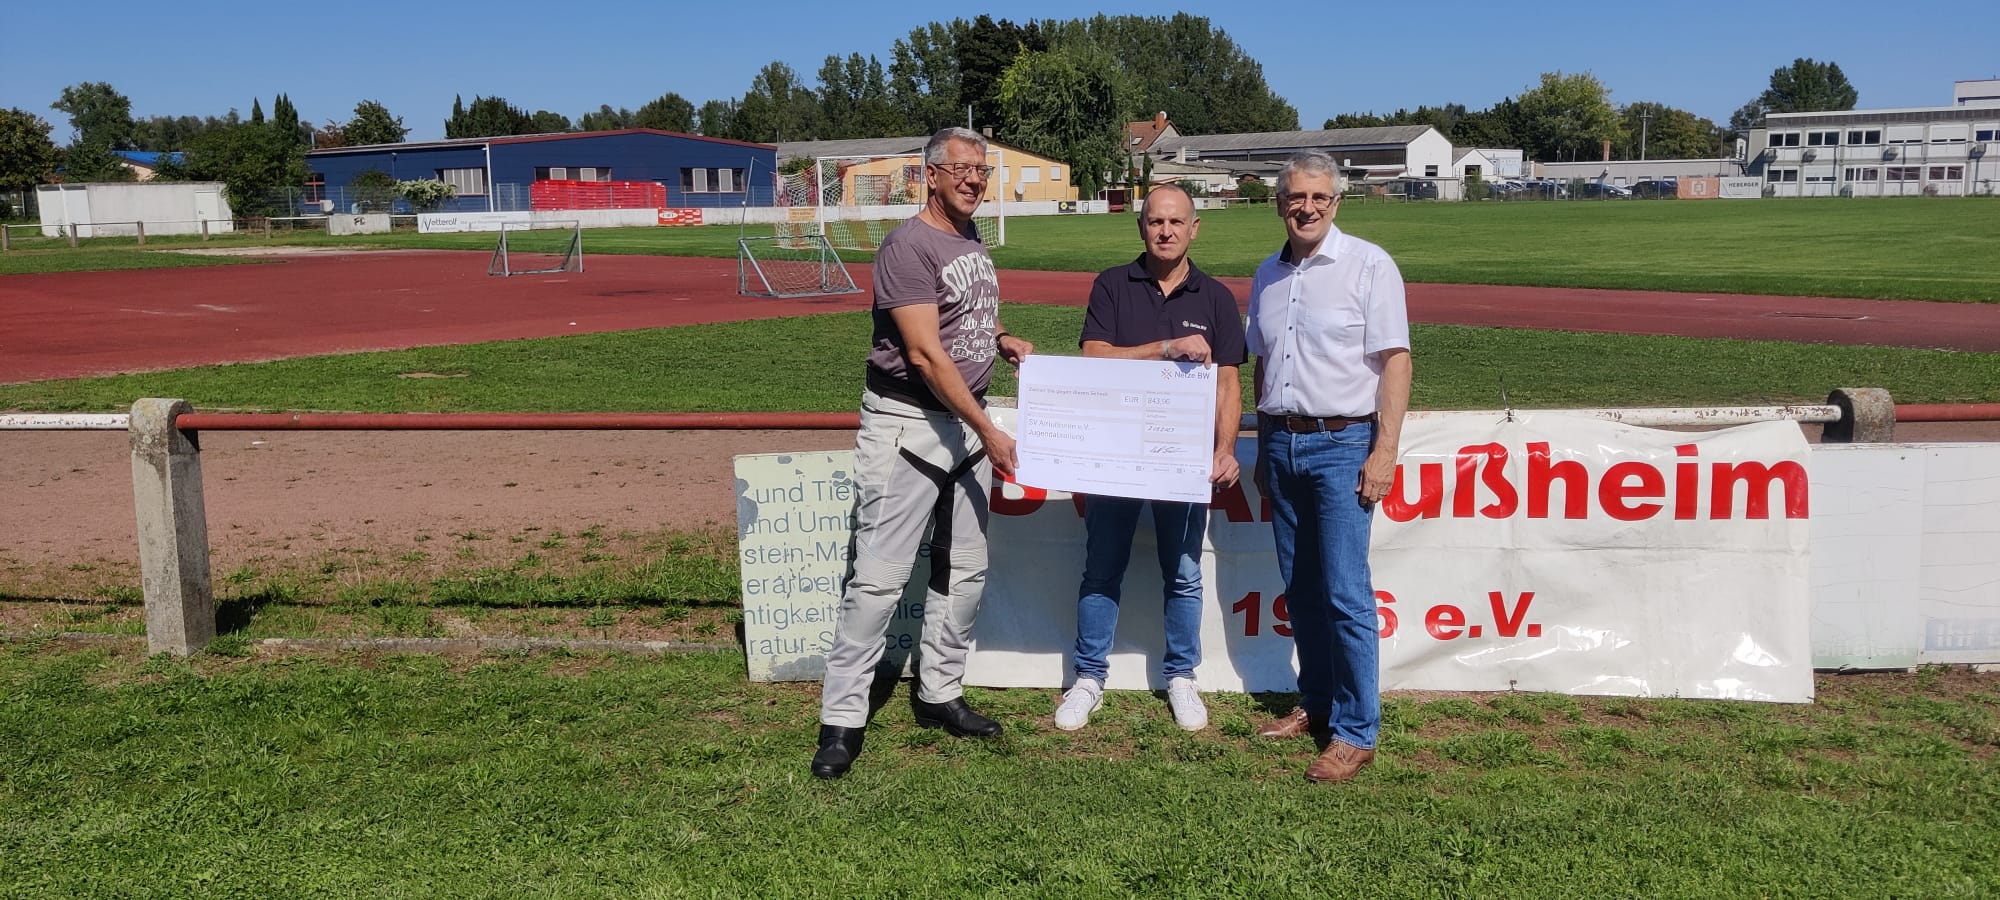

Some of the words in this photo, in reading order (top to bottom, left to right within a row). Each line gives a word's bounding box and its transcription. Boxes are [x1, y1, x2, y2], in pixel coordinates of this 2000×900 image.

[1174, 371, 1196, 379] Netze
[1197, 372, 1210, 380] BW
[1124, 395, 1139, 404] EUR
[755, 481, 803, 504] und
[799, 509, 858, 533] Umb
[1233, 588, 1398, 640] 196
[1425, 591, 1541, 640] e.V.
